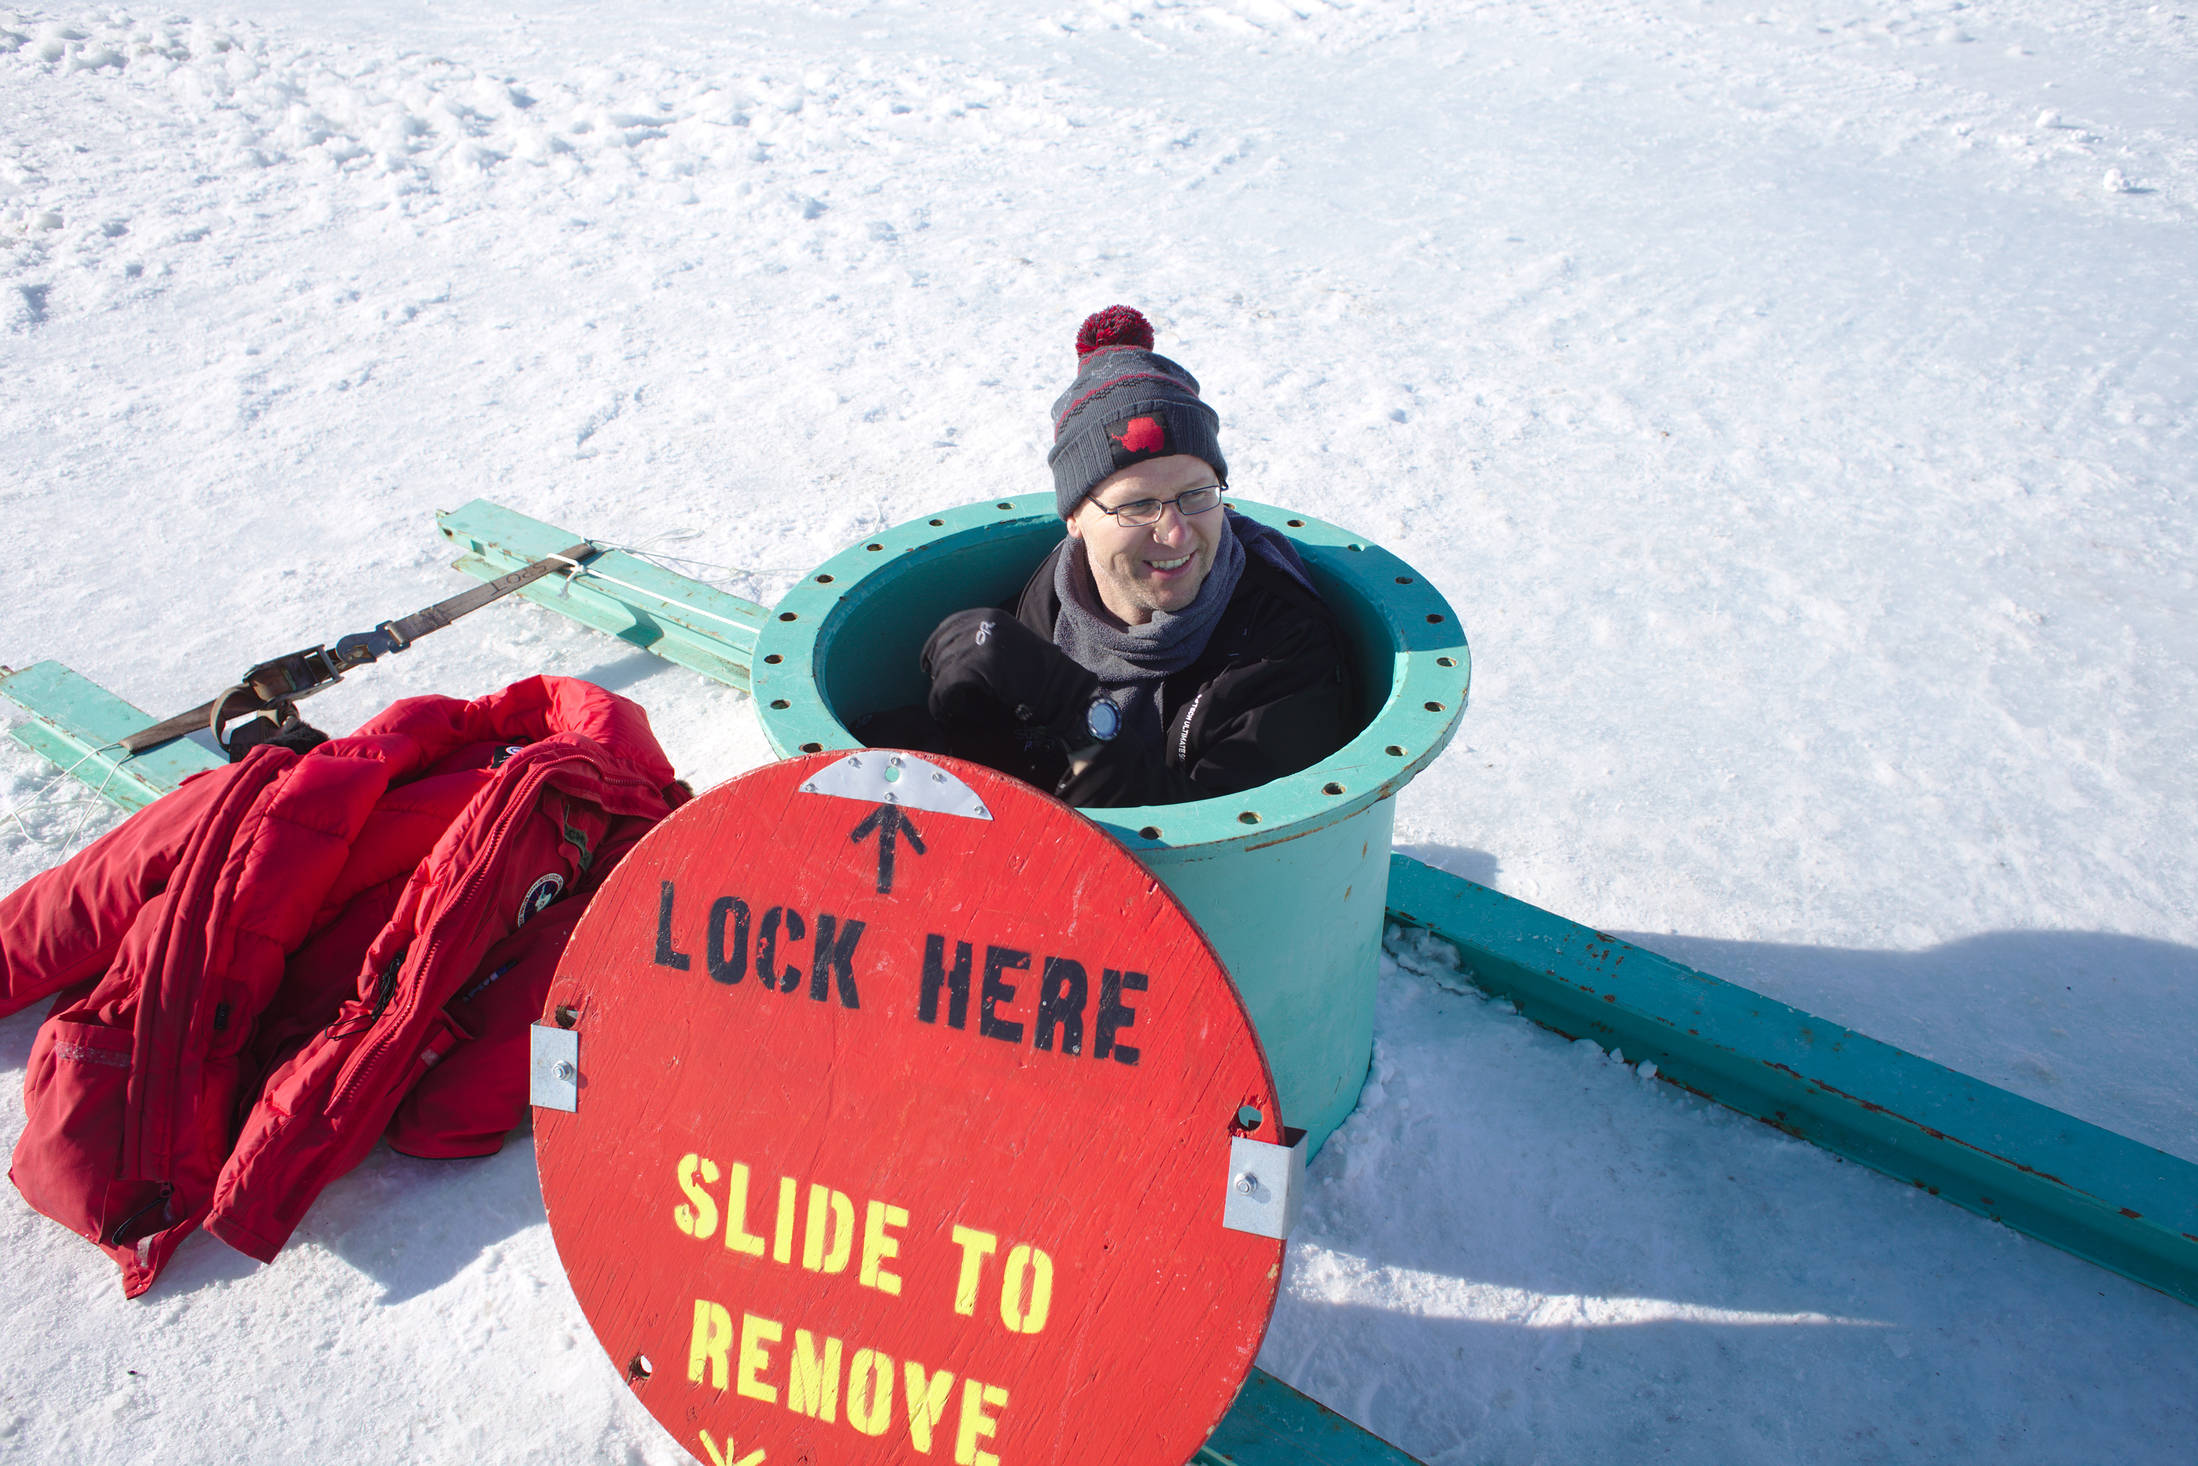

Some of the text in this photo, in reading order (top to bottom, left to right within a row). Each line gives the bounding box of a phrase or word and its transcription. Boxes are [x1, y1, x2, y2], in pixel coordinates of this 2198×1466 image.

[1178, 720, 1191, 754] ULTIMATE
[654, 881, 866, 1009] LOCK
[918, 934, 1149, 1066] HERE
[674, 1153, 1054, 1334] SLIDE TO
[688, 1299, 1009, 1466] REMOVE
